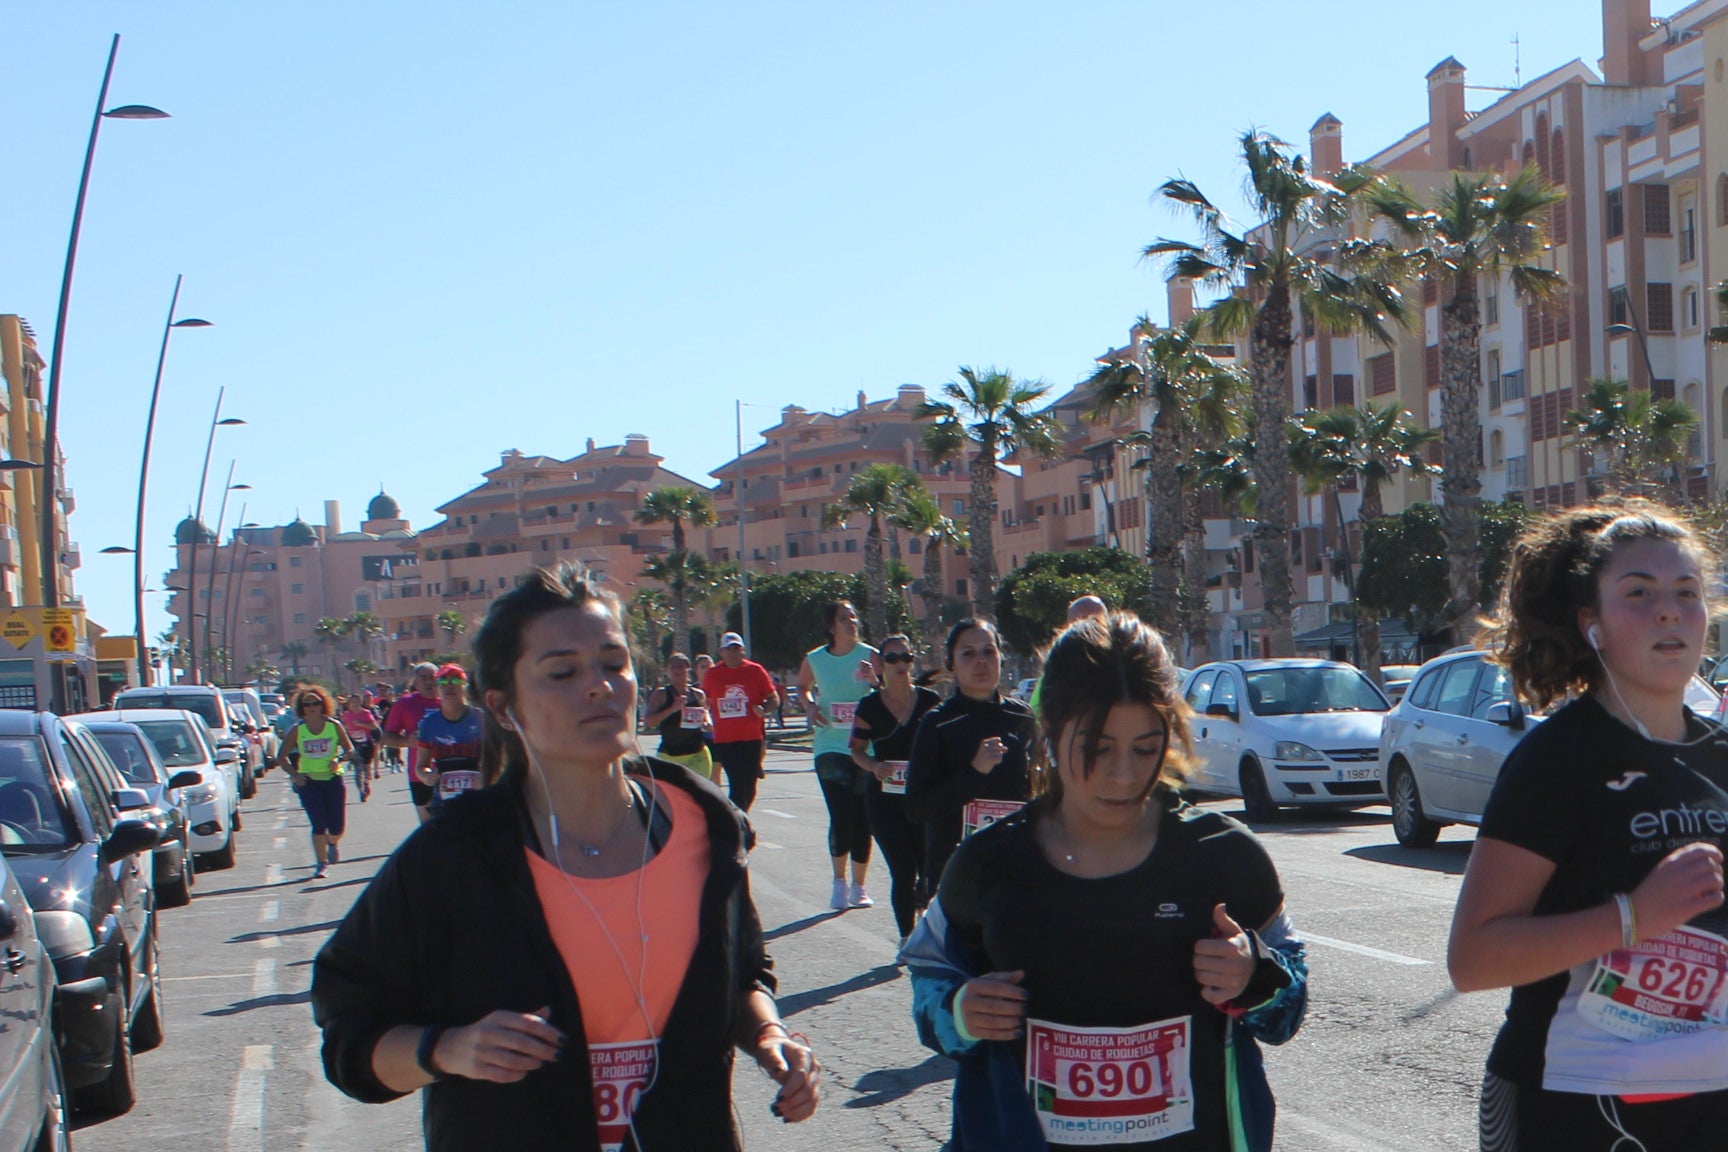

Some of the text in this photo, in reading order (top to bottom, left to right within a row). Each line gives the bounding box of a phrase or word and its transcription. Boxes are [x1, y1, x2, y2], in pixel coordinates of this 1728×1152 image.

[1346, 769, 1370, 779] 1987
[1639, 957, 1708, 1002] 626
[1053, 1030, 1159, 1046] VIII CARRERA POPULAR
[1053, 1043, 1154, 1060] CIUDAD DE ROQUETAS
[1068, 1060, 1152, 1098] 690
[1050, 1112, 1169, 1133] meetingpoint
